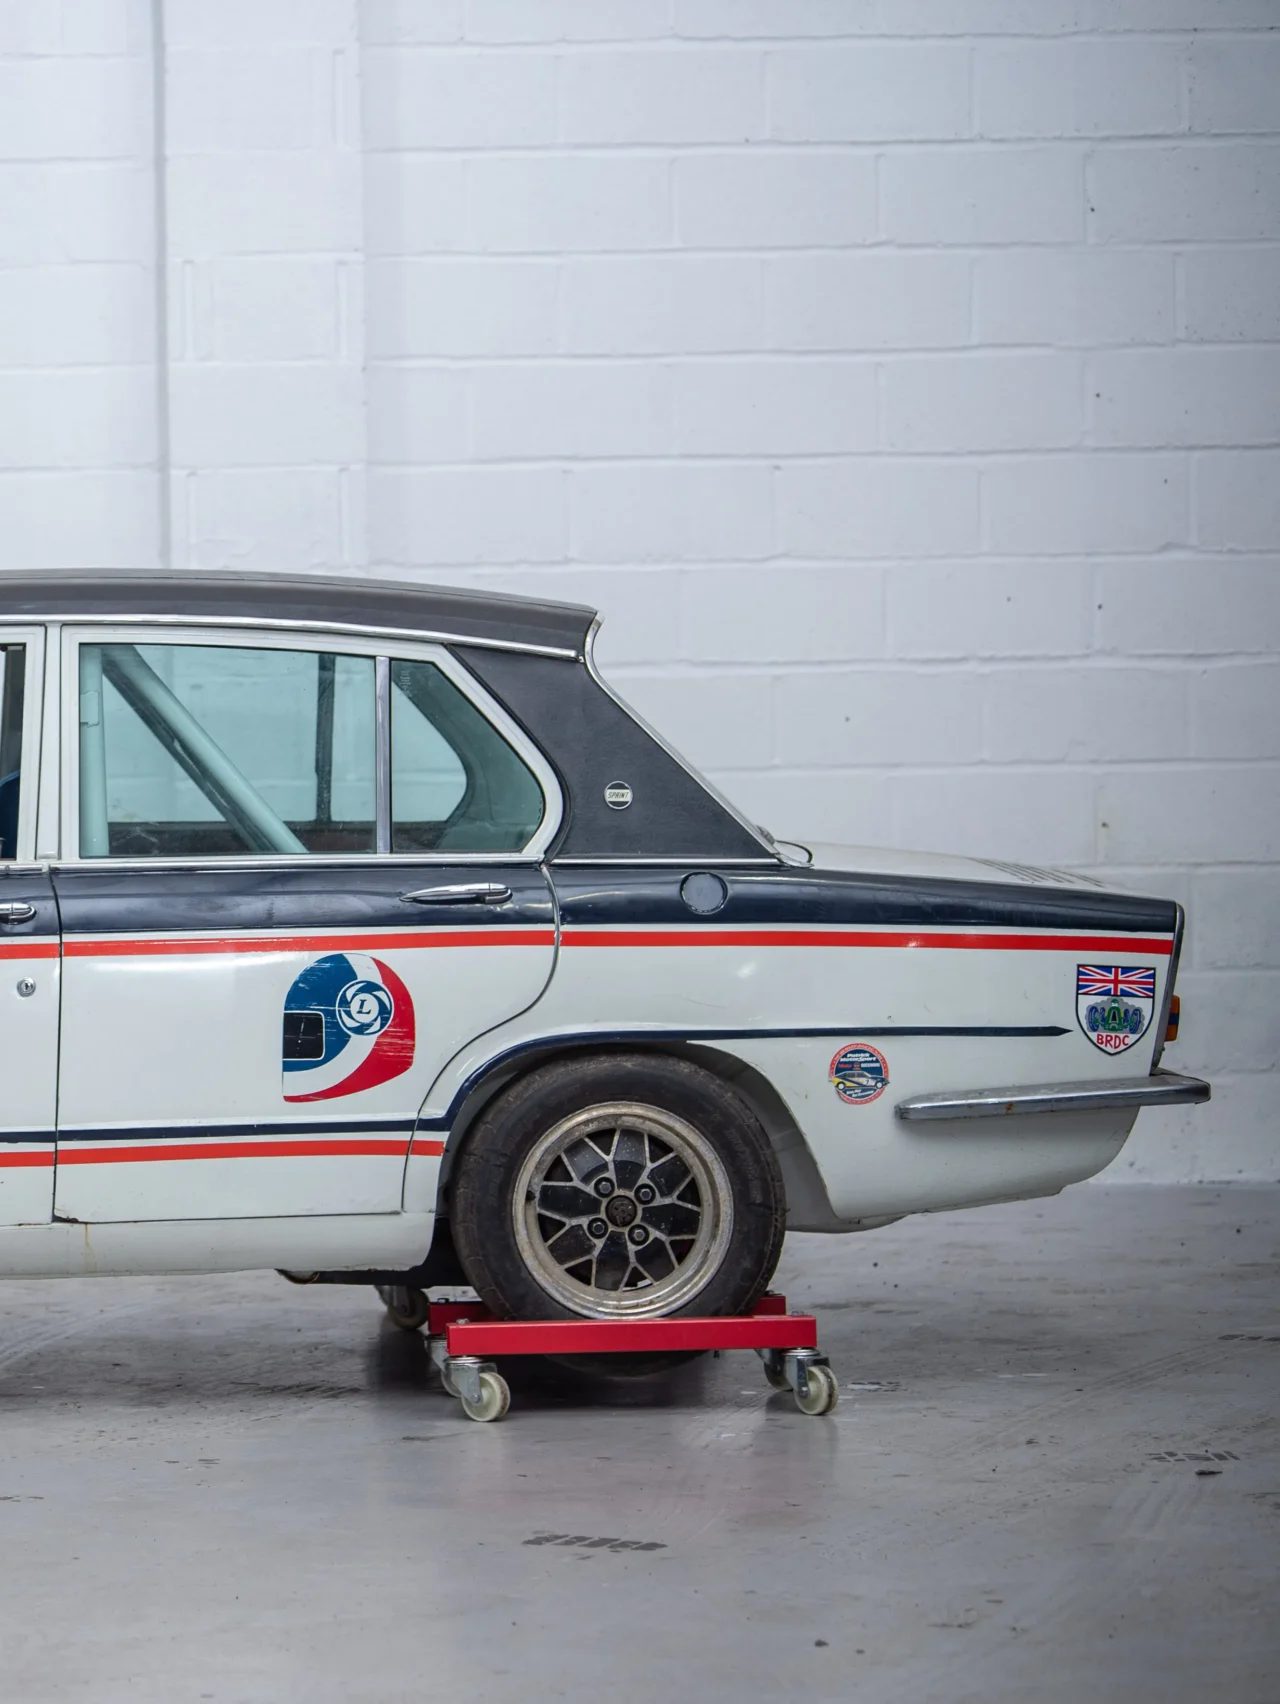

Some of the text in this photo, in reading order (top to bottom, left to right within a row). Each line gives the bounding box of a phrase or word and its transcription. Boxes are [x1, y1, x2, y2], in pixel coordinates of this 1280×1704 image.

[608, 791, 629, 799] SPRINT
[356, 999, 372, 1015] L
[1096, 1033, 1130, 1050] BRDC
